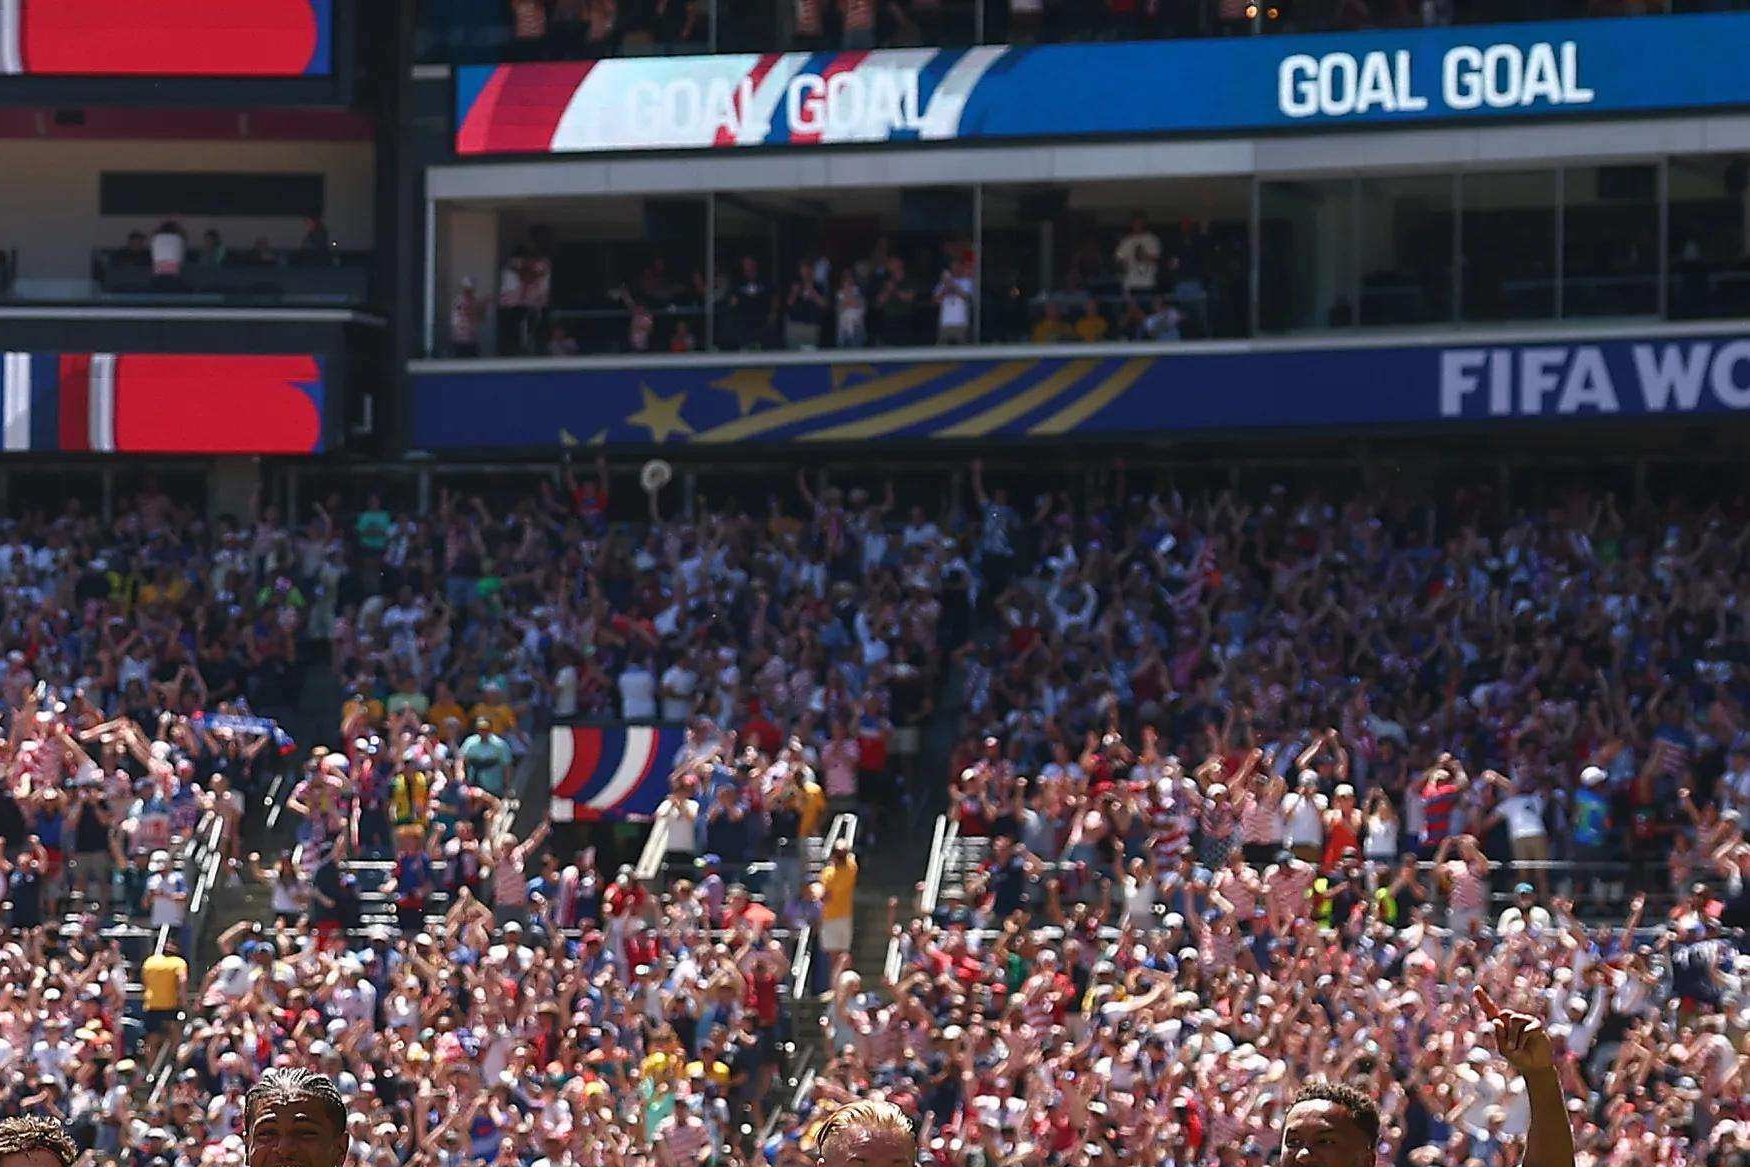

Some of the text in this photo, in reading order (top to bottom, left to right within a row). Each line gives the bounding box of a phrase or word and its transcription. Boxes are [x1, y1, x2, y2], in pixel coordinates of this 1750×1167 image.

[627, 68, 926, 134] GOAL GOAL
[1278, 41, 1594, 118] GOAL GOAL
[1440, 347, 1620, 417] FIFA
